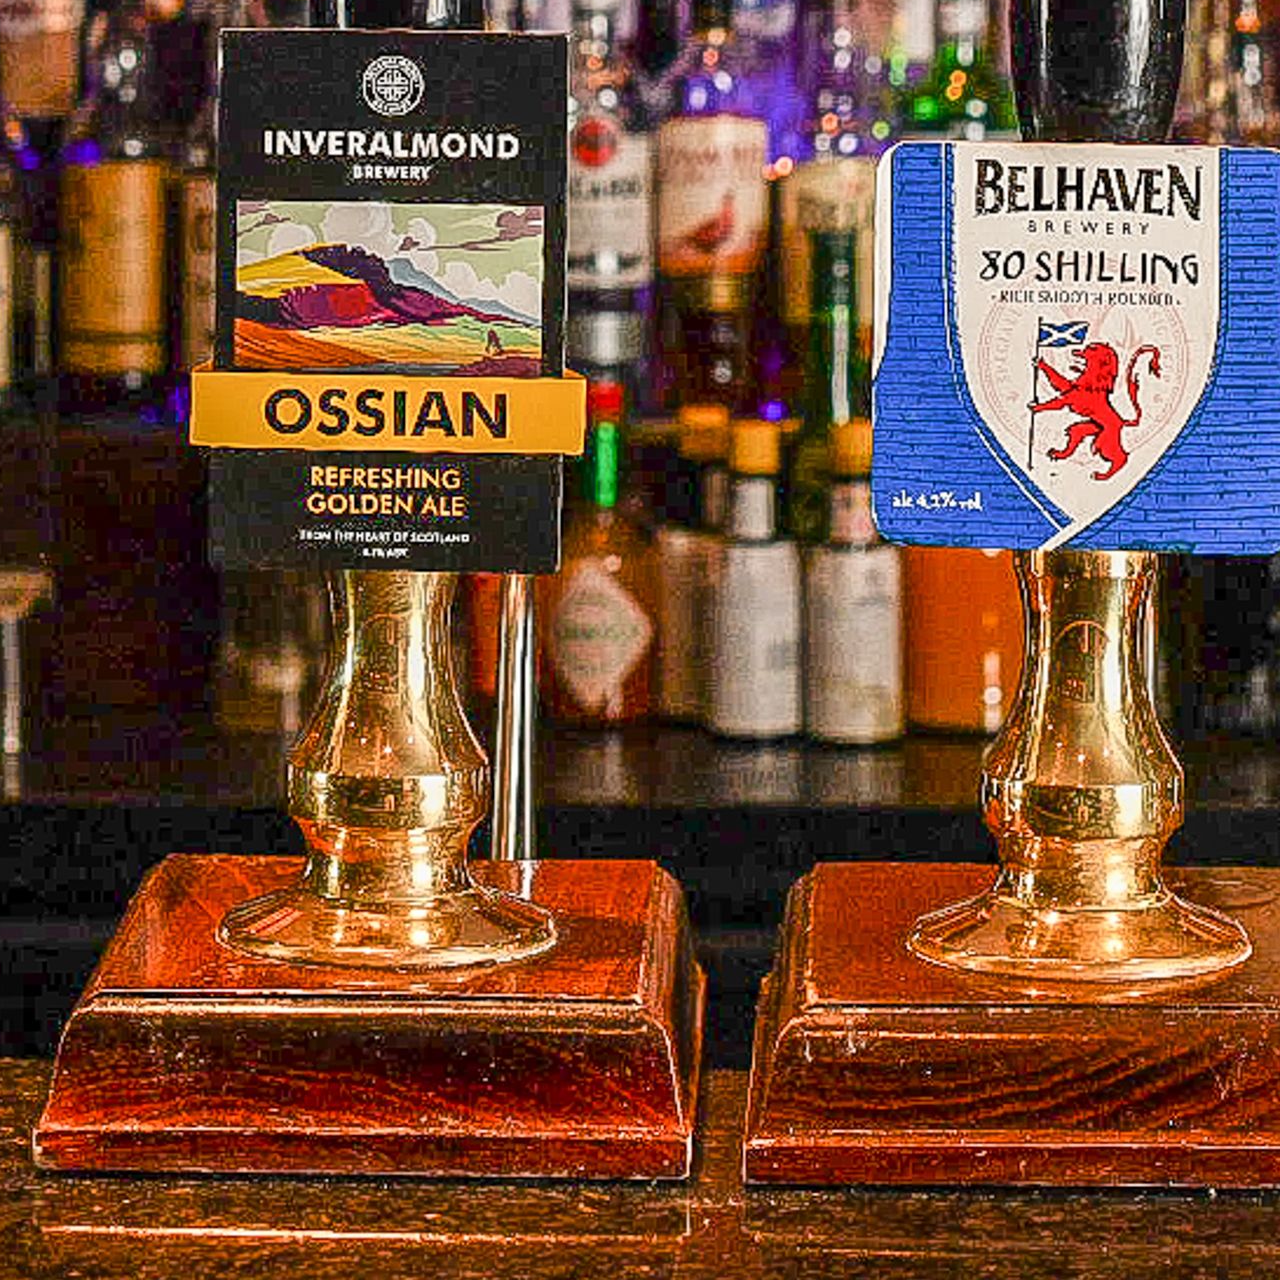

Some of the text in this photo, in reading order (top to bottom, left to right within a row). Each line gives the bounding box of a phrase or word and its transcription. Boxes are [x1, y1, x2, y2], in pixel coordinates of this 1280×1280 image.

[263, 129, 521, 160] INVERALMOND
[353, 165, 432, 181] BREWERY
[974, 158, 1203, 221] BELHAVEN
[1027, 219, 1150, 236] BREWERY
[979, 249, 1200, 286] 80 SHILLING
[264, 388, 508, 440] OSSIAN
[309, 466, 462, 490] REFRESHING
[306, 493, 466, 518] GOLDEN ALE
